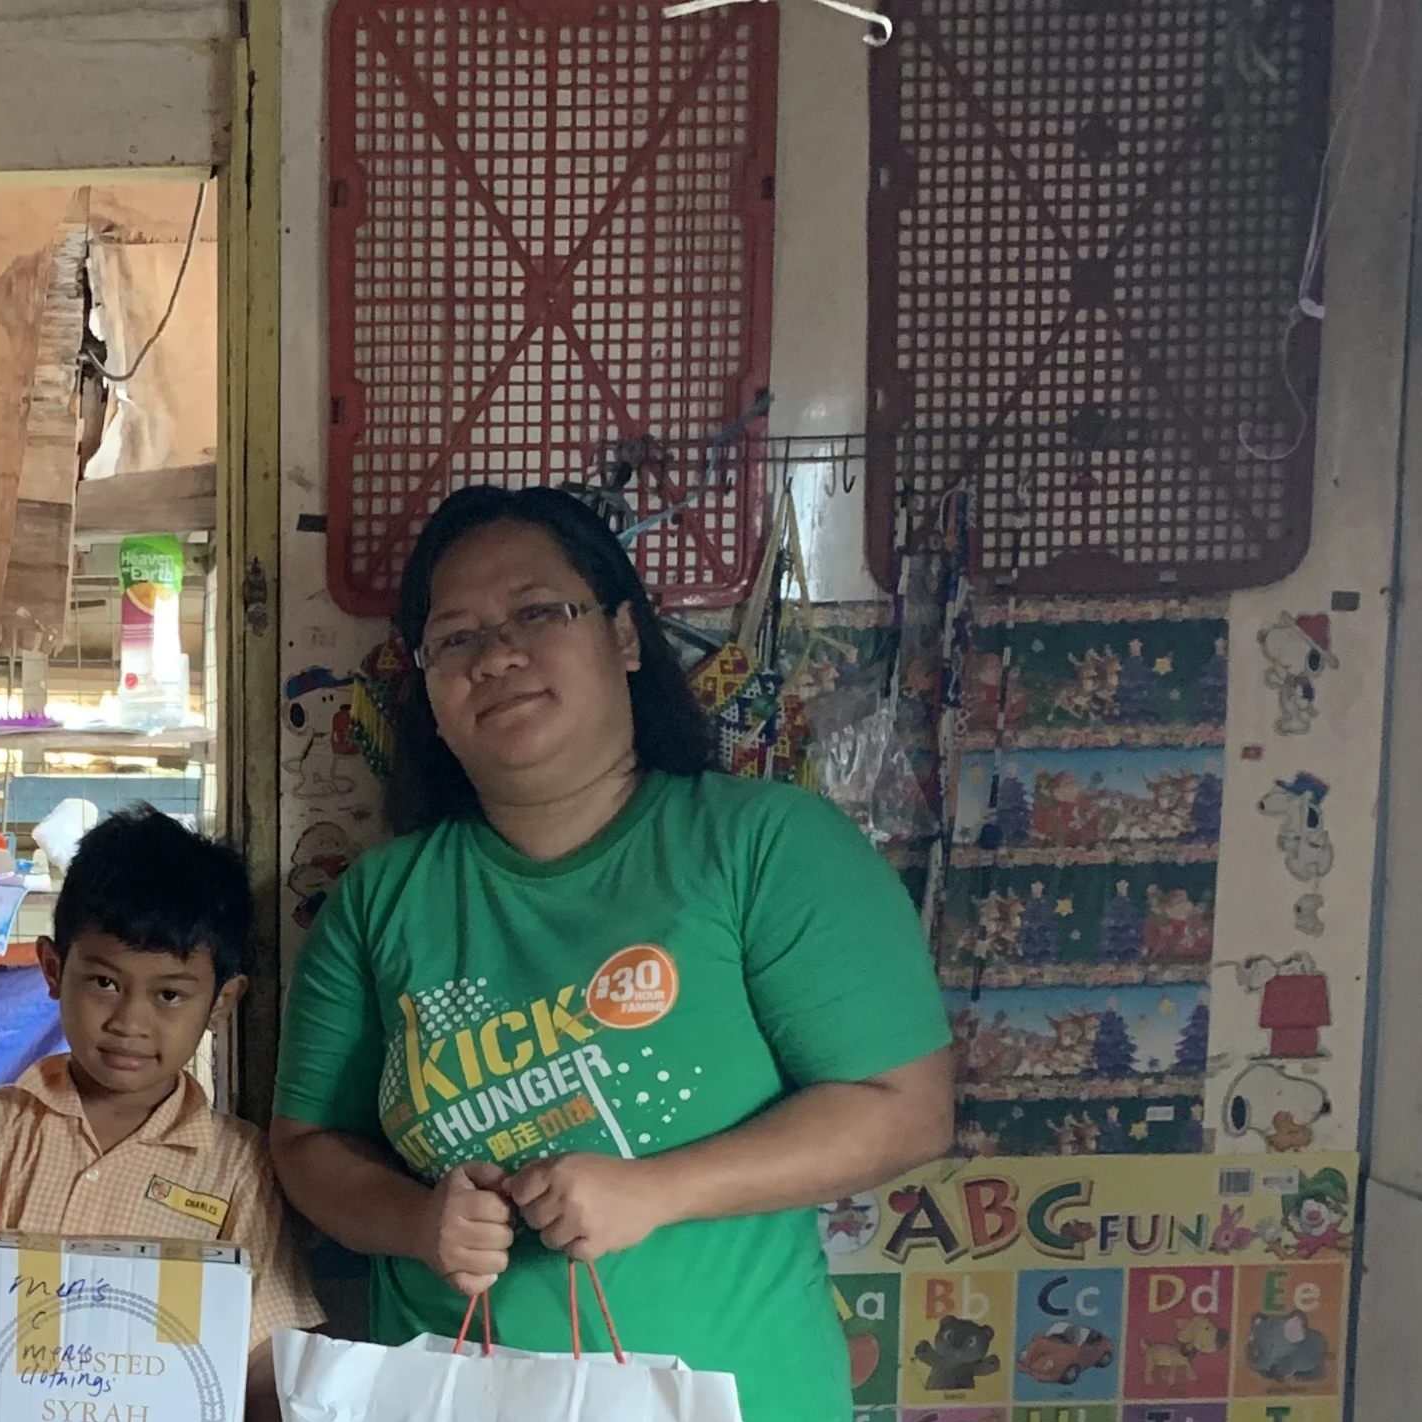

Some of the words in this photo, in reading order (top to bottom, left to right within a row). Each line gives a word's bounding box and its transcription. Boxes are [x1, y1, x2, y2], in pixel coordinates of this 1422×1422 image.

[398, 984, 592, 1115] KICK
[433, 1043, 612, 1148] HUNGER
[184, 1198, 219, 1216] CHARLES
[881, 1174, 1095, 1265] ABC
[1097, 1212, 1210, 1256] FUN
[56, 1351, 166, 1378] APSTED
